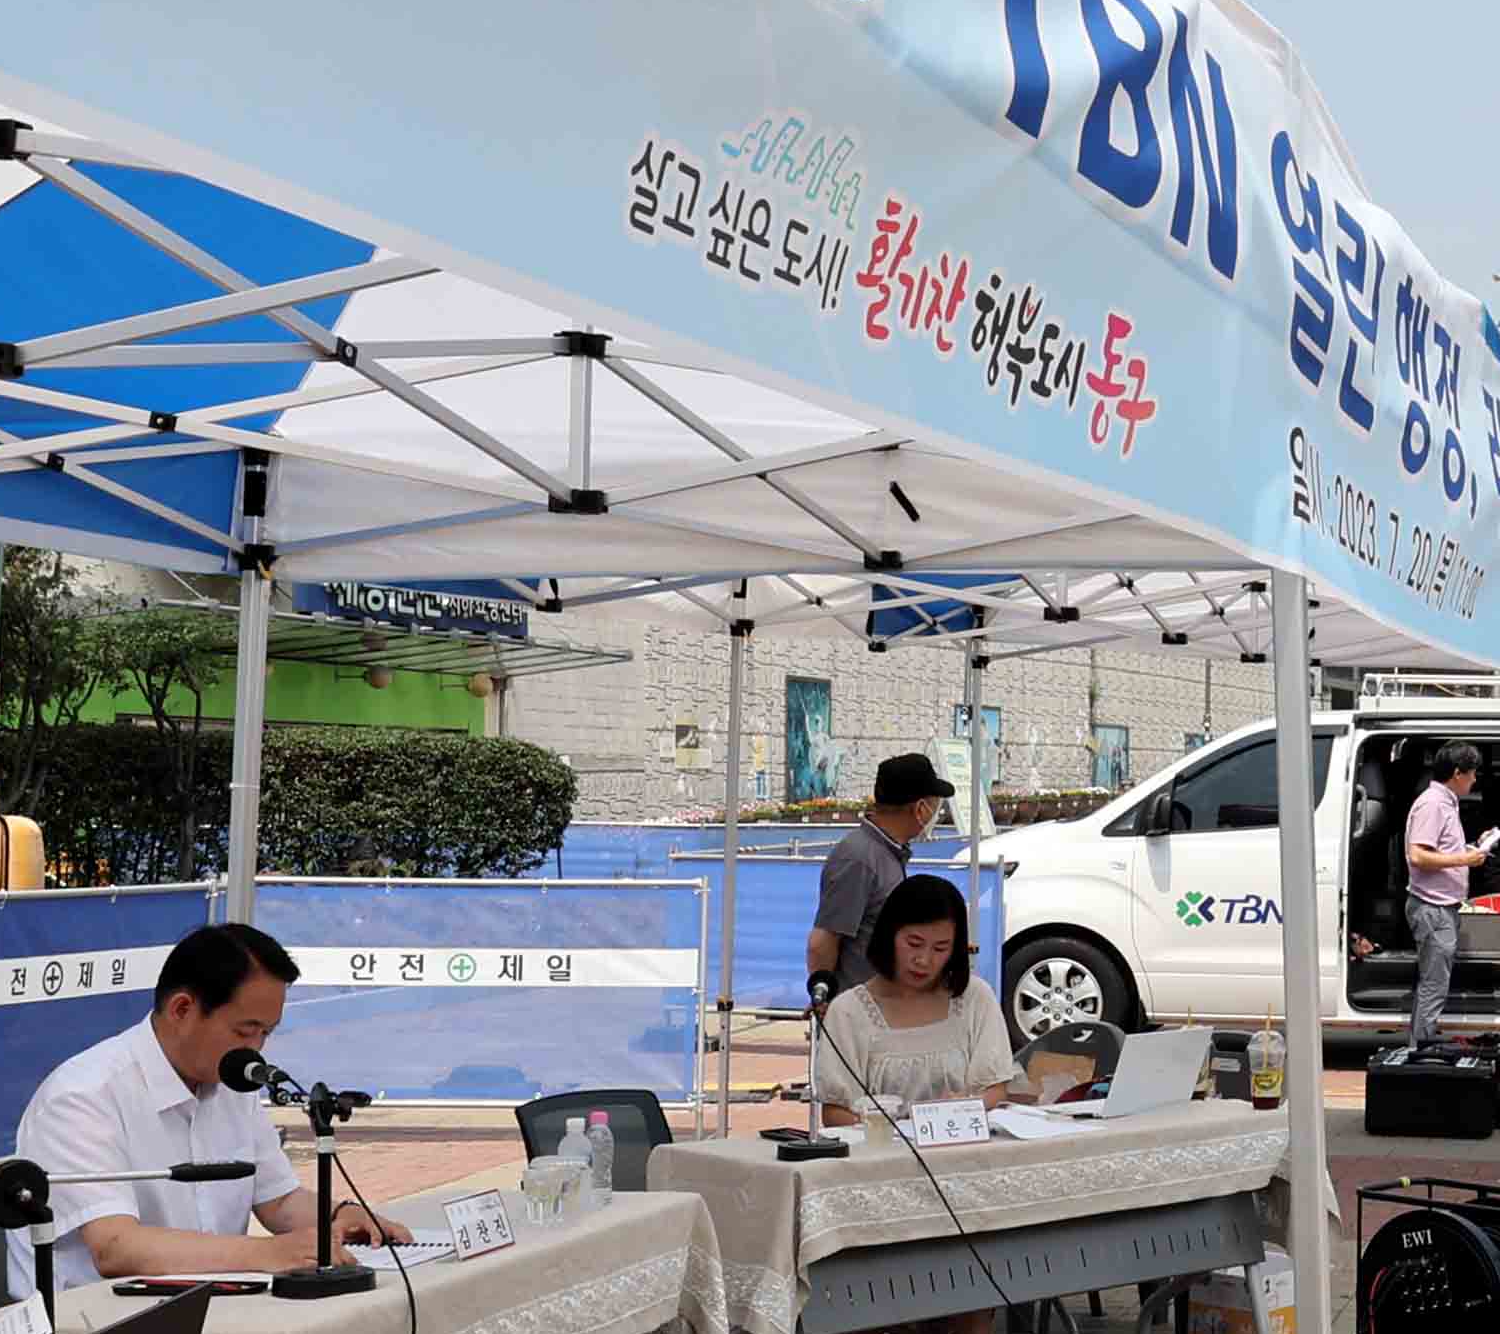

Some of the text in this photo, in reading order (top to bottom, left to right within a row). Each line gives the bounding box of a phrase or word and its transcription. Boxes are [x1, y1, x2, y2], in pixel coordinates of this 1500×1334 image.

[705, 180, 773, 282] 싶은
[855, 198, 968, 354] 활기찬
[1270, 130, 1385, 432] 열린
[76, 957, 128, 990] 제일
[349, 953, 573, 983] 안전 제일
[1401, 1228, 1433, 1249] EWI
